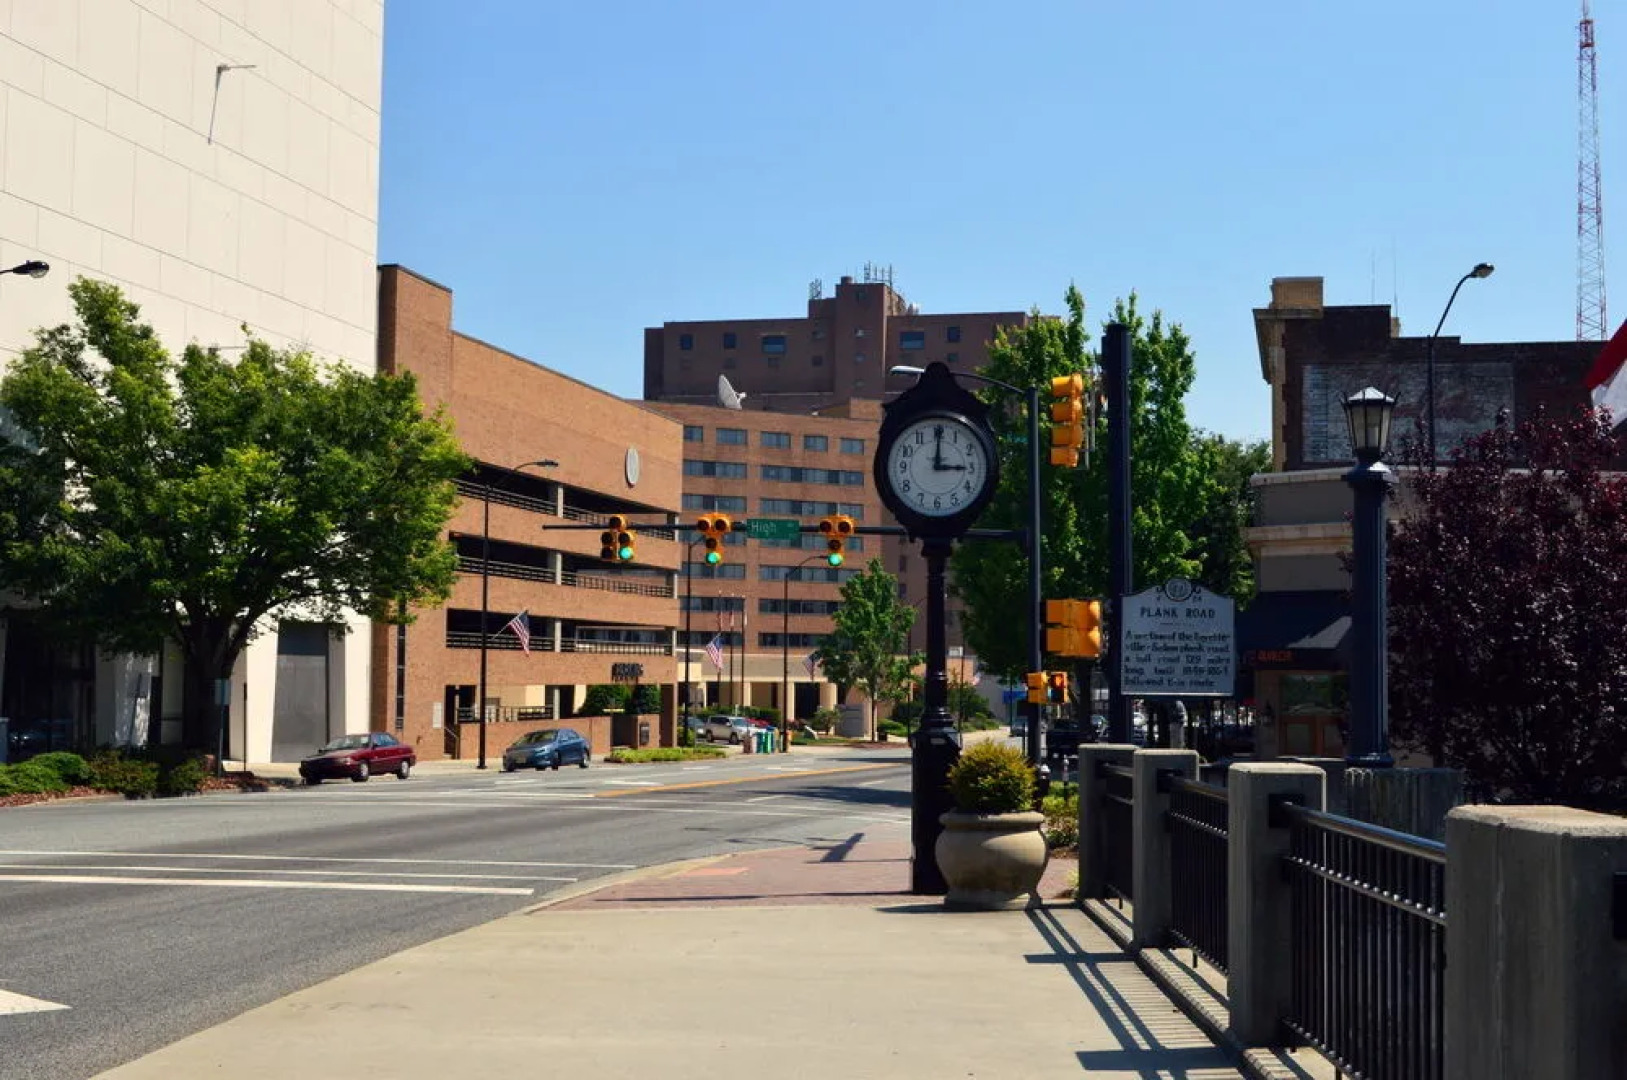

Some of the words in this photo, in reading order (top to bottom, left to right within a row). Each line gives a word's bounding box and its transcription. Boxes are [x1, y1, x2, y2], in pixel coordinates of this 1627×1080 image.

[966, 443, 975, 456] 2
[900, 461, 907, 473] 9
[967, 462, 975, 474] 3
[902, 480, 910, 492] 8
[917, 492, 925, 507] 7
[933, 496, 941, 508] 6
[950, 492, 960, 506] 5
[751, 521, 777, 538] High
[1140, 607, 1179, 618] PLANK
[1185, 608, 1216, 618] ROAD
[1157, 655, 1180, 664] rod
[1124, 676, 1164, 686] follwed
